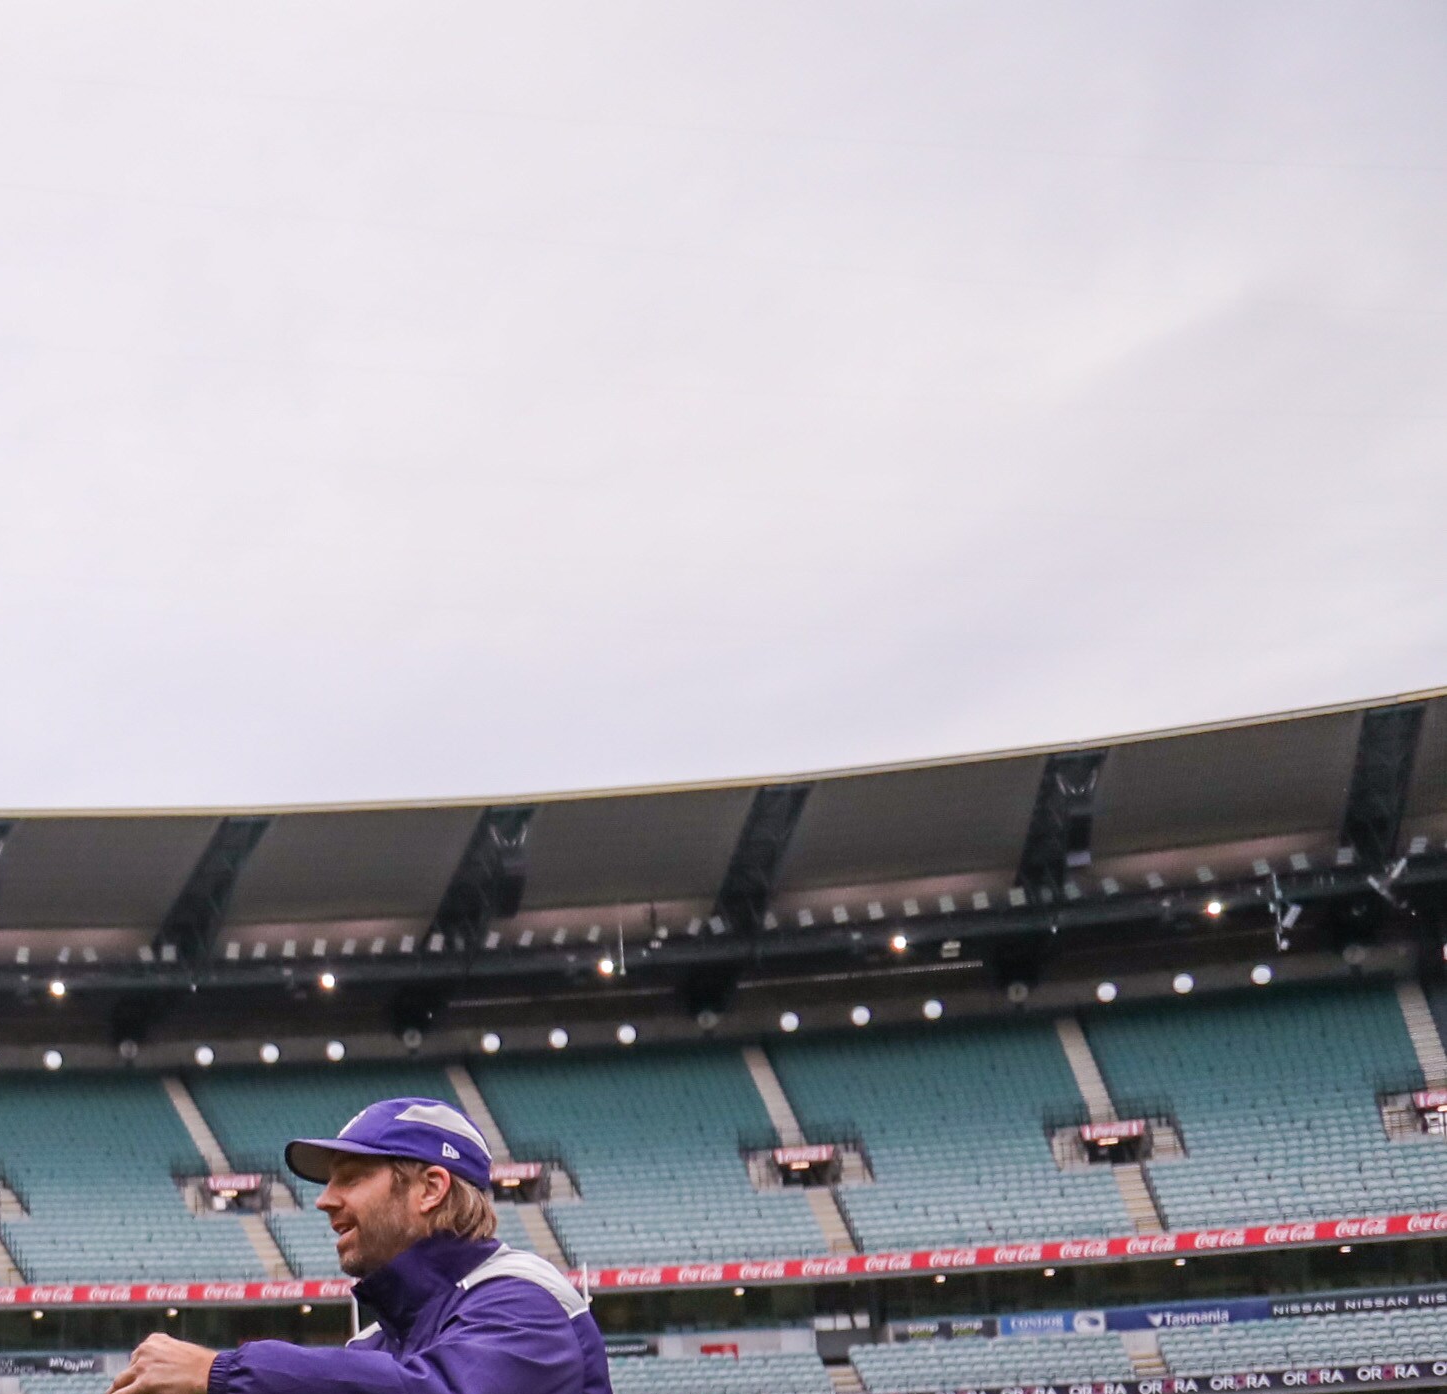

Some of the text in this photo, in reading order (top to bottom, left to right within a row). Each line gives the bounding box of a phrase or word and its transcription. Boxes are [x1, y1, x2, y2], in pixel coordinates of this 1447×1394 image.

[1273, 1291, 1447, 1316] NISSAN NISSAN NIS
[1164, 1309, 1230, 1327] Tasmania
[1210, 1373, 1270, 1391] ORORA
[1282, 1369, 1344, 1386] ORORA
[1357, 1364, 1419, 1382] ORORA
